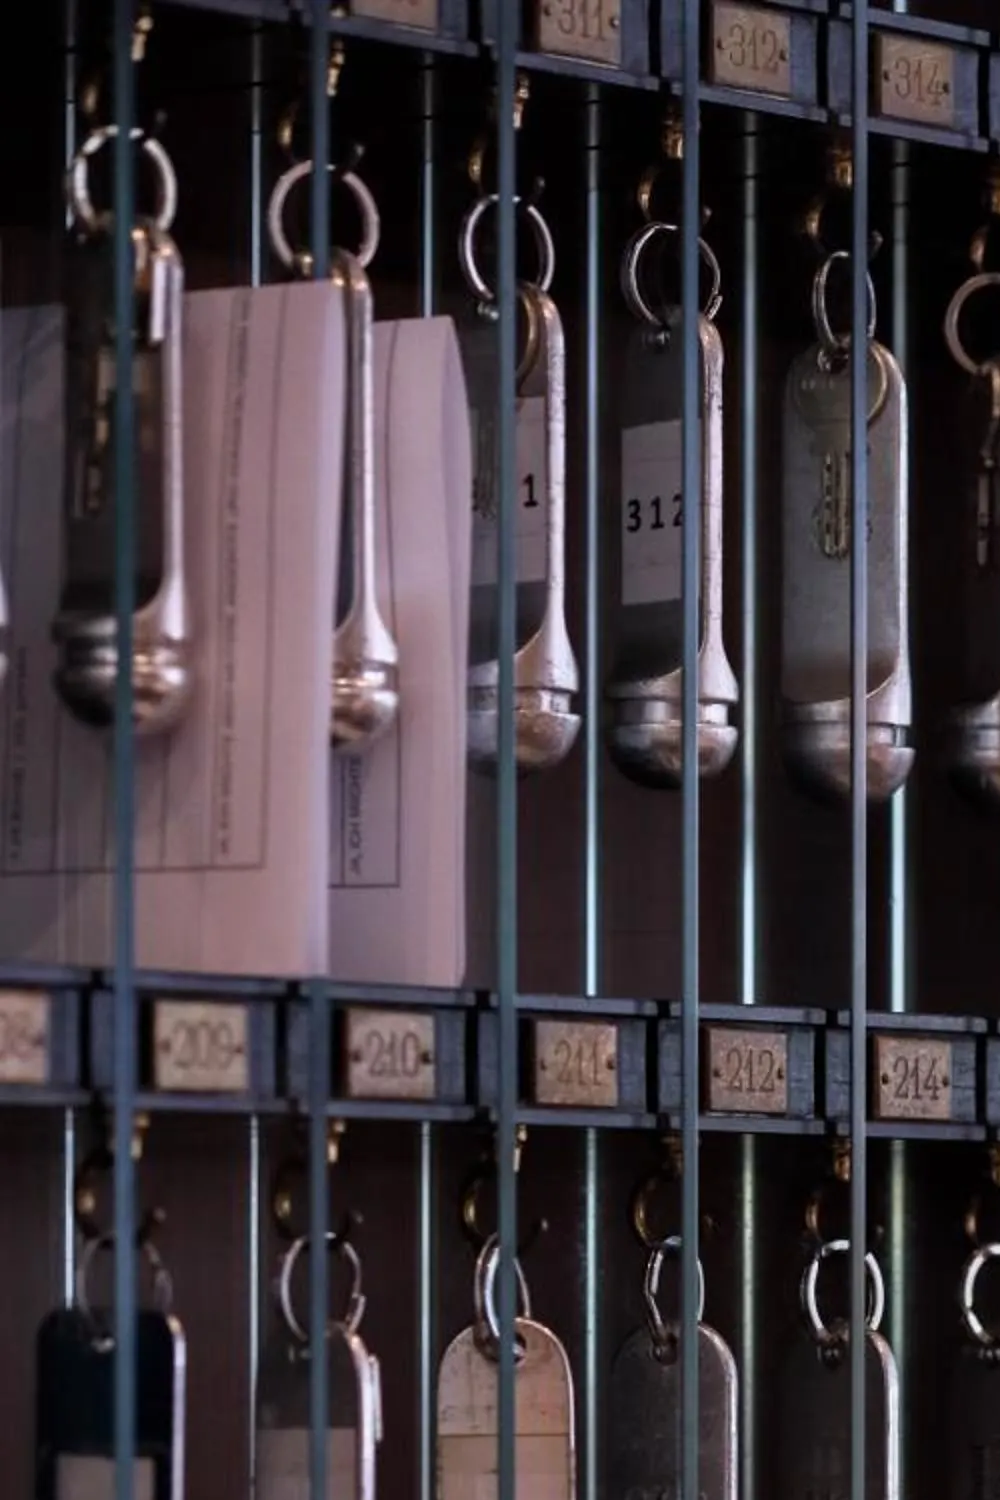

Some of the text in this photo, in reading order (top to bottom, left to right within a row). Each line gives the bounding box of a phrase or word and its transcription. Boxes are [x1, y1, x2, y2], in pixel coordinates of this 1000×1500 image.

[557, 0, 606, 41] 311
[729, 23, 778, 74] 312
[895, 57, 942, 105] 314
[173, 1019, 235, 1070] 209
[367, 1029, 420, 1078] 210
[554, 1039, 602, 1087] 211
[726, 1048, 775, 1093] 212
[893, 1055, 940, 1101] 214
